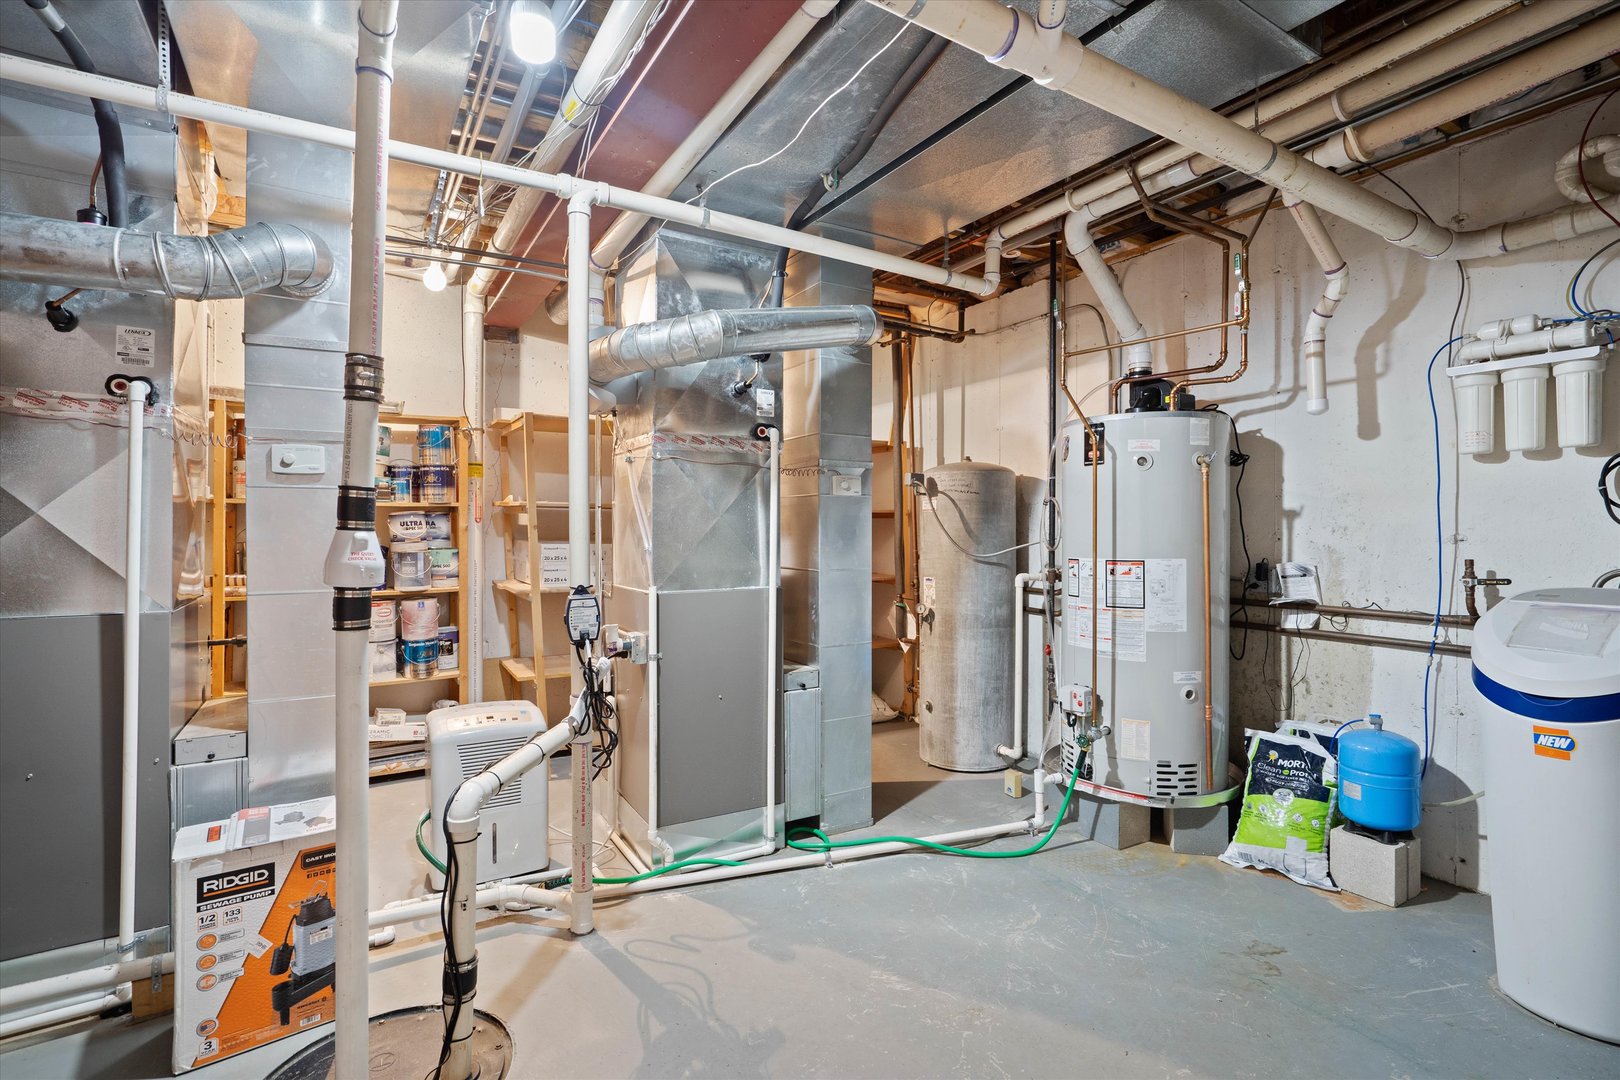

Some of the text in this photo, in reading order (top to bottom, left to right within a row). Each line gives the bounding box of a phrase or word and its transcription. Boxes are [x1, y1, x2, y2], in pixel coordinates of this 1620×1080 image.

[1537, 734, 1572, 748] NEW
[1258, 763, 1281, 774] Clean
[1277, 759, 1307, 768] MORT
[203, 869, 269, 893] RIDGID
[200, 890, 272, 911] SEWAGE PUMP
[225, 909, 240, 917] 133
[199, 914, 216, 924] 1/2
[204, 1041, 212, 1050] 3
